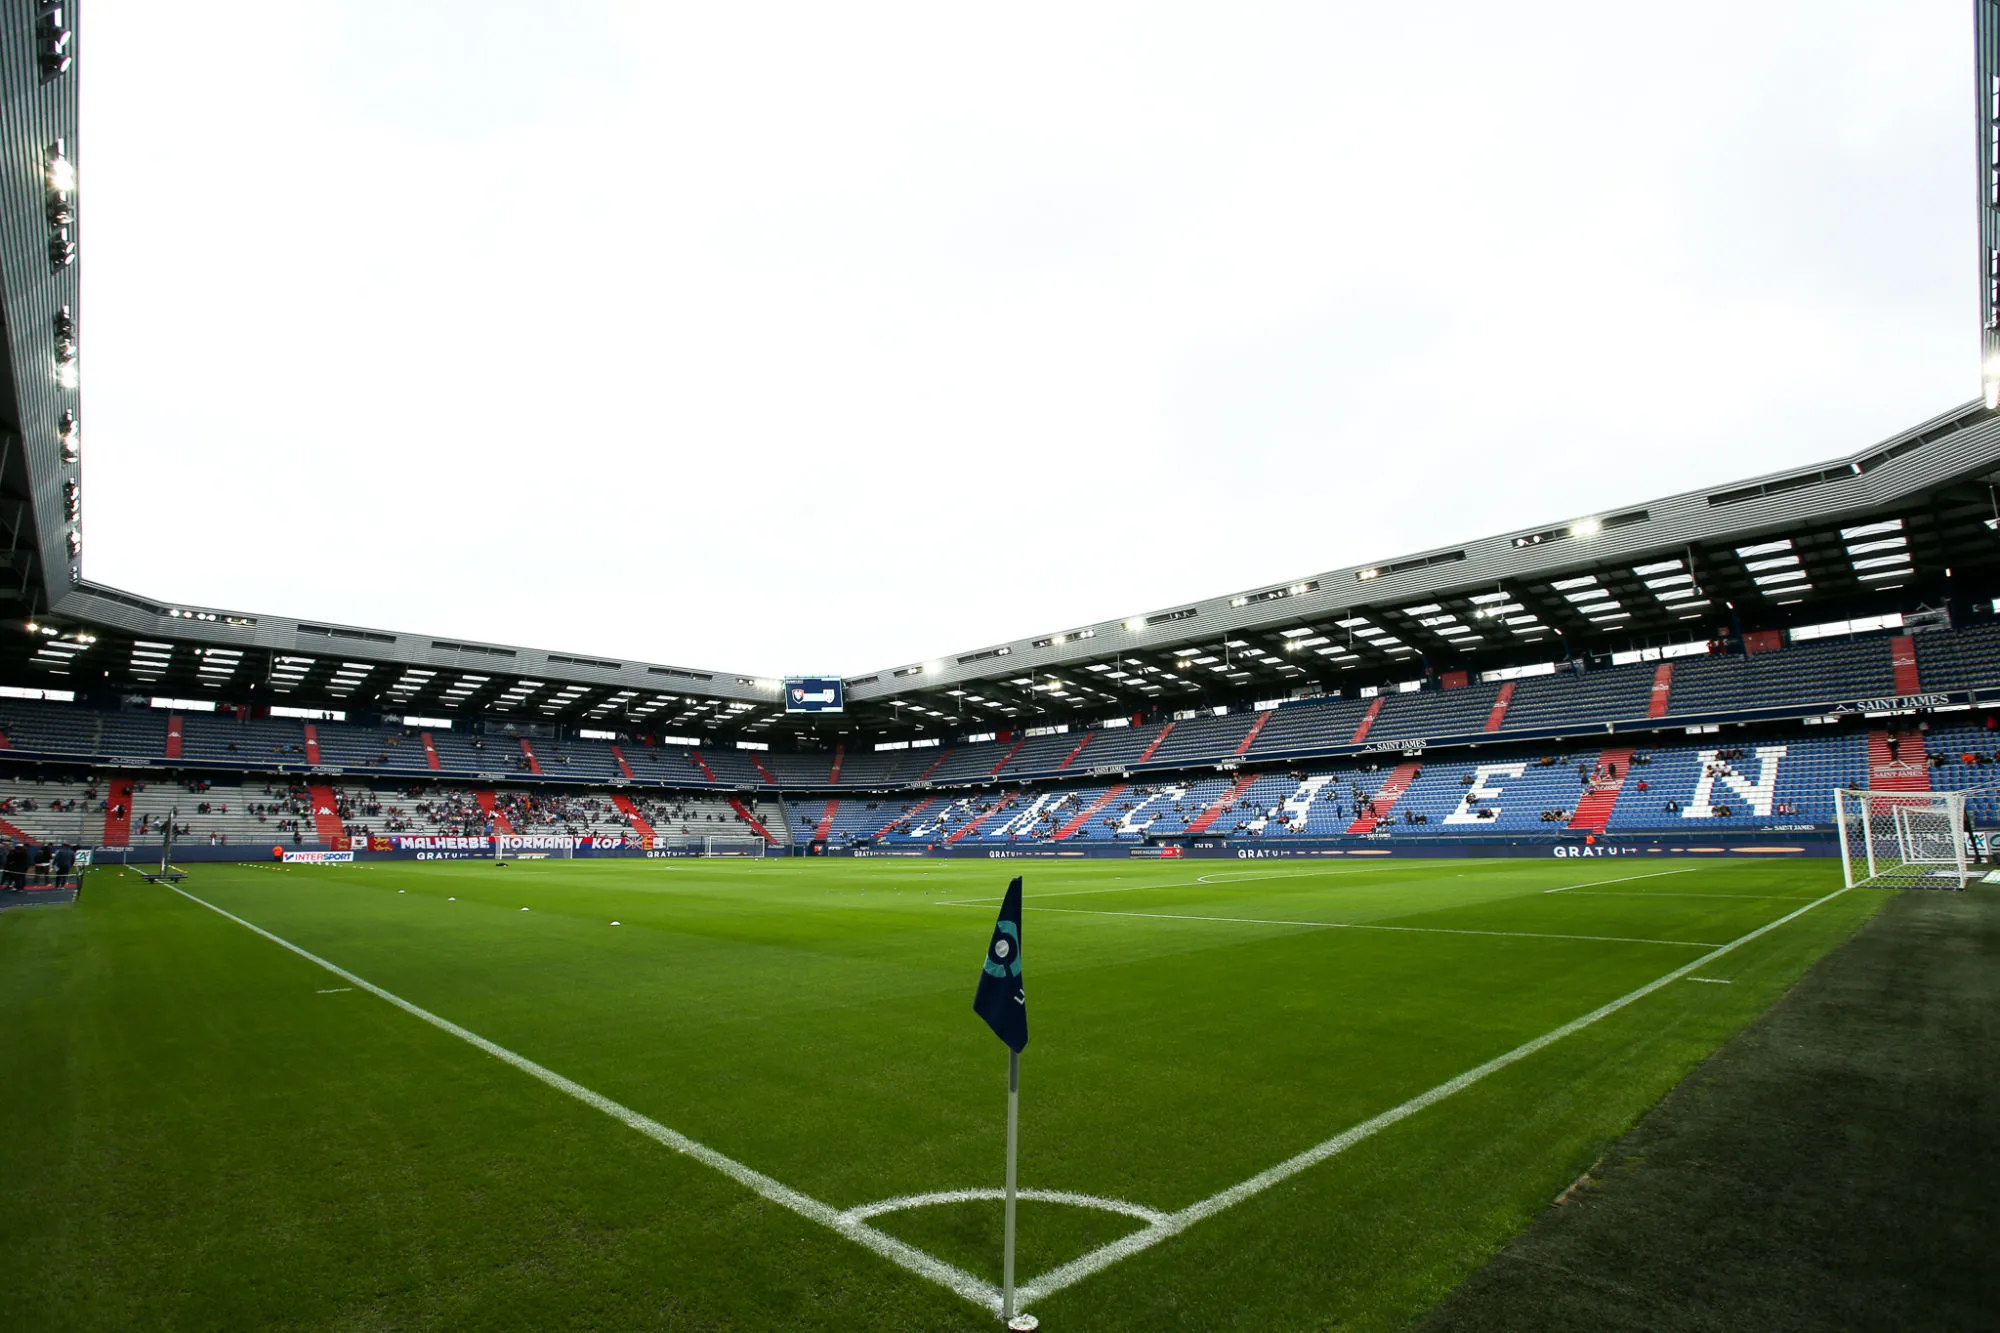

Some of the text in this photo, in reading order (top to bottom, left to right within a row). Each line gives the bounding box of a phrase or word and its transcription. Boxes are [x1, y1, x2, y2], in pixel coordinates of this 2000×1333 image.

[1856, 693, 1950, 712] SAINT JAMES
[1377, 740, 1427, 751] SAINT JAMES
[399, 837, 622, 850] MALHERBE NORMANDY KOP
[295, 852, 352, 862] INTERSPORT
